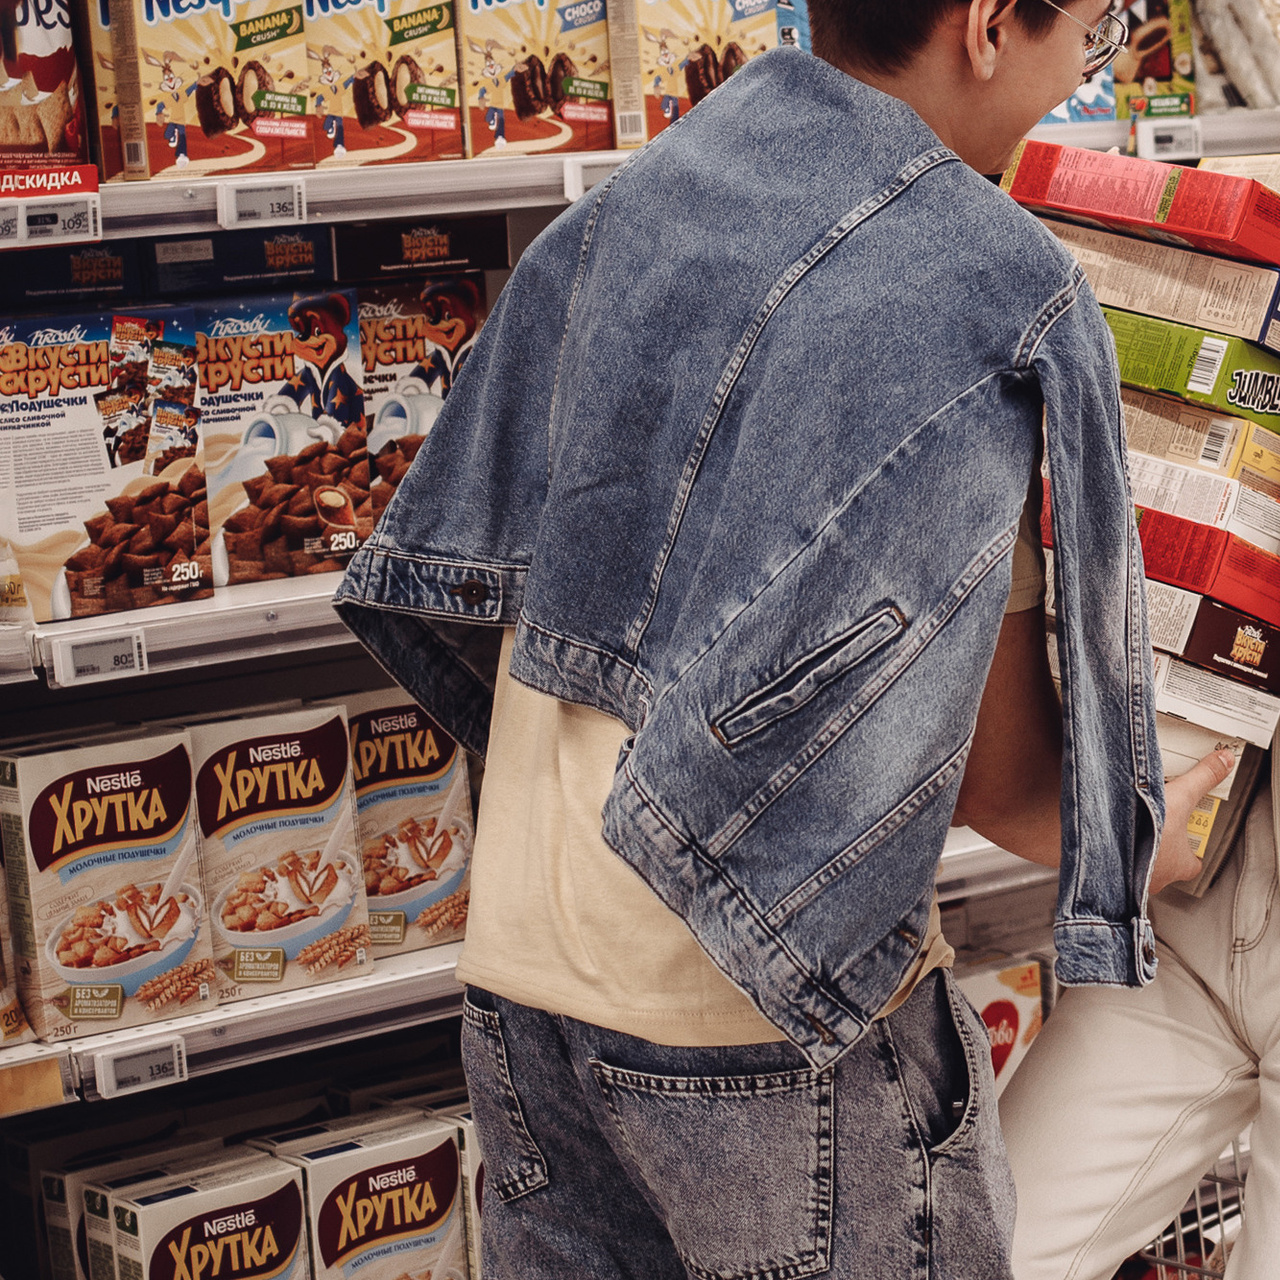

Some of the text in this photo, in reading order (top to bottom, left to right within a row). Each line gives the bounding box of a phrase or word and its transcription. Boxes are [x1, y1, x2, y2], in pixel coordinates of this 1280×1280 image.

[200, 392, 264, 407] одушечки
[331, 531, 356, 552] 250
[172, 561, 199, 582] 250
